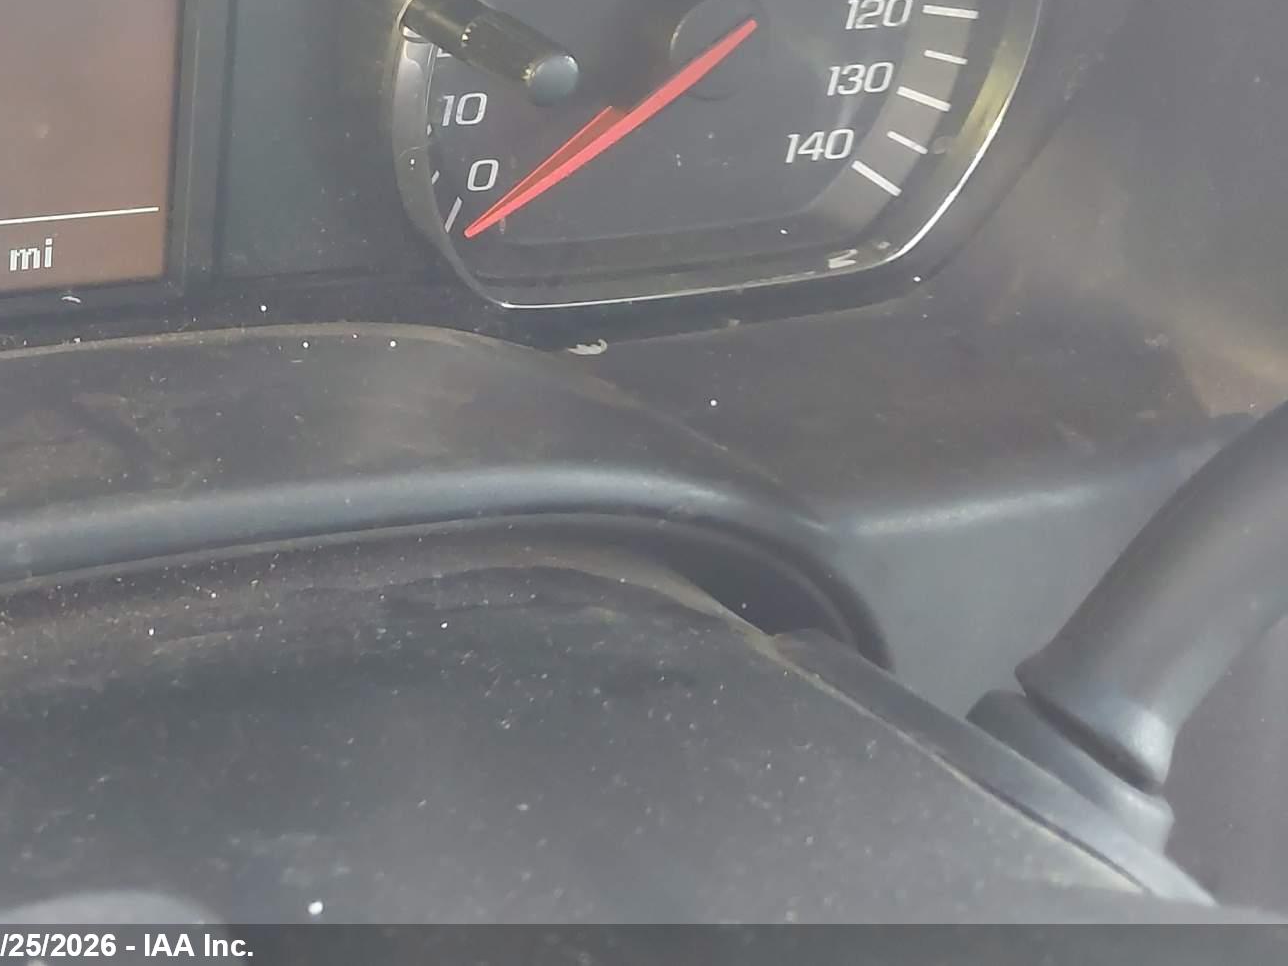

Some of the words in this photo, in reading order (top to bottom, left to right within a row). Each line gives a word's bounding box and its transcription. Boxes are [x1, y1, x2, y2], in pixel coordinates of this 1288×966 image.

[827, 62, 894, 96] 130
[441, 92, 488, 126] 10
[784, 129, 854, 163] 140
[467, 159, 499, 191] 0
[9, 237, 54, 272] mi
